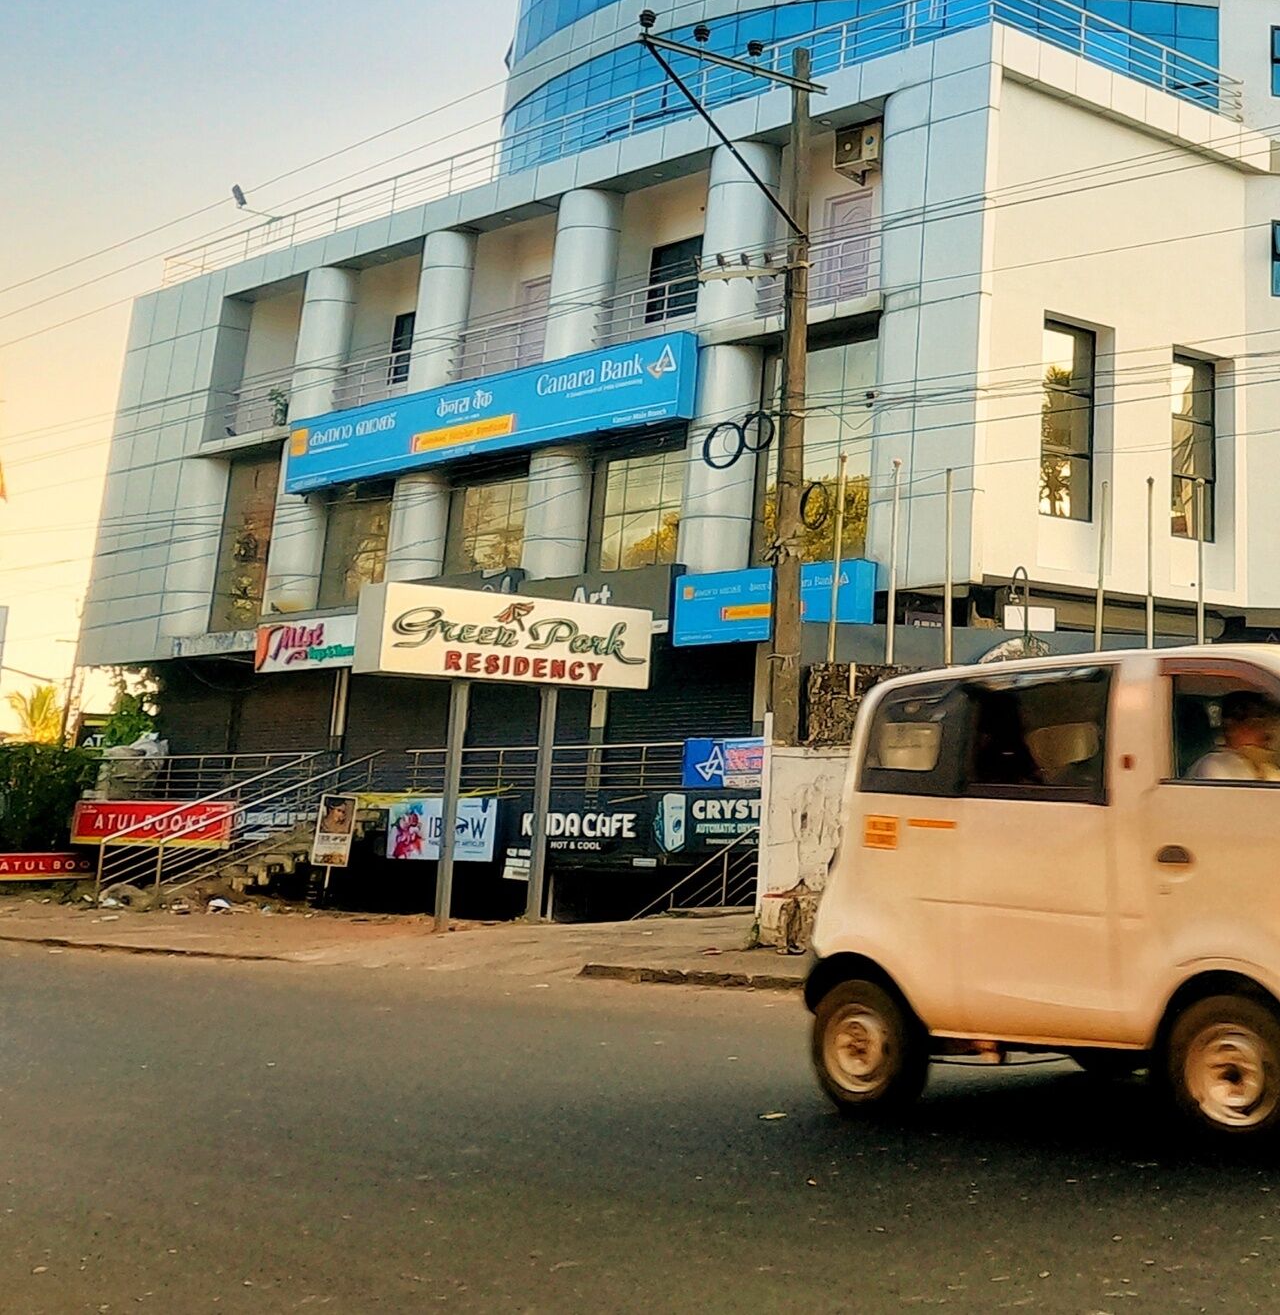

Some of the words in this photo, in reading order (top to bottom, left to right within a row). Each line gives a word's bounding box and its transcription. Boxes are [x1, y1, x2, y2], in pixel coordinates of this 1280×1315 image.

[536, 368, 596, 397] Canara
[600, 353, 643, 383] Bank
[392, 606, 518, 648] Green
[525, 617, 647, 665] Park
[444, 650, 604, 682] RESIDENCY
[692, 799, 761, 820] CRYST
[582, 813, 637, 838] CAFE
[551, 841, 568, 849] HOT
[569, 841, 575, 849] &
[577, 841, 601, 851] COOL
[0, 860, 47, 871] ATUL
